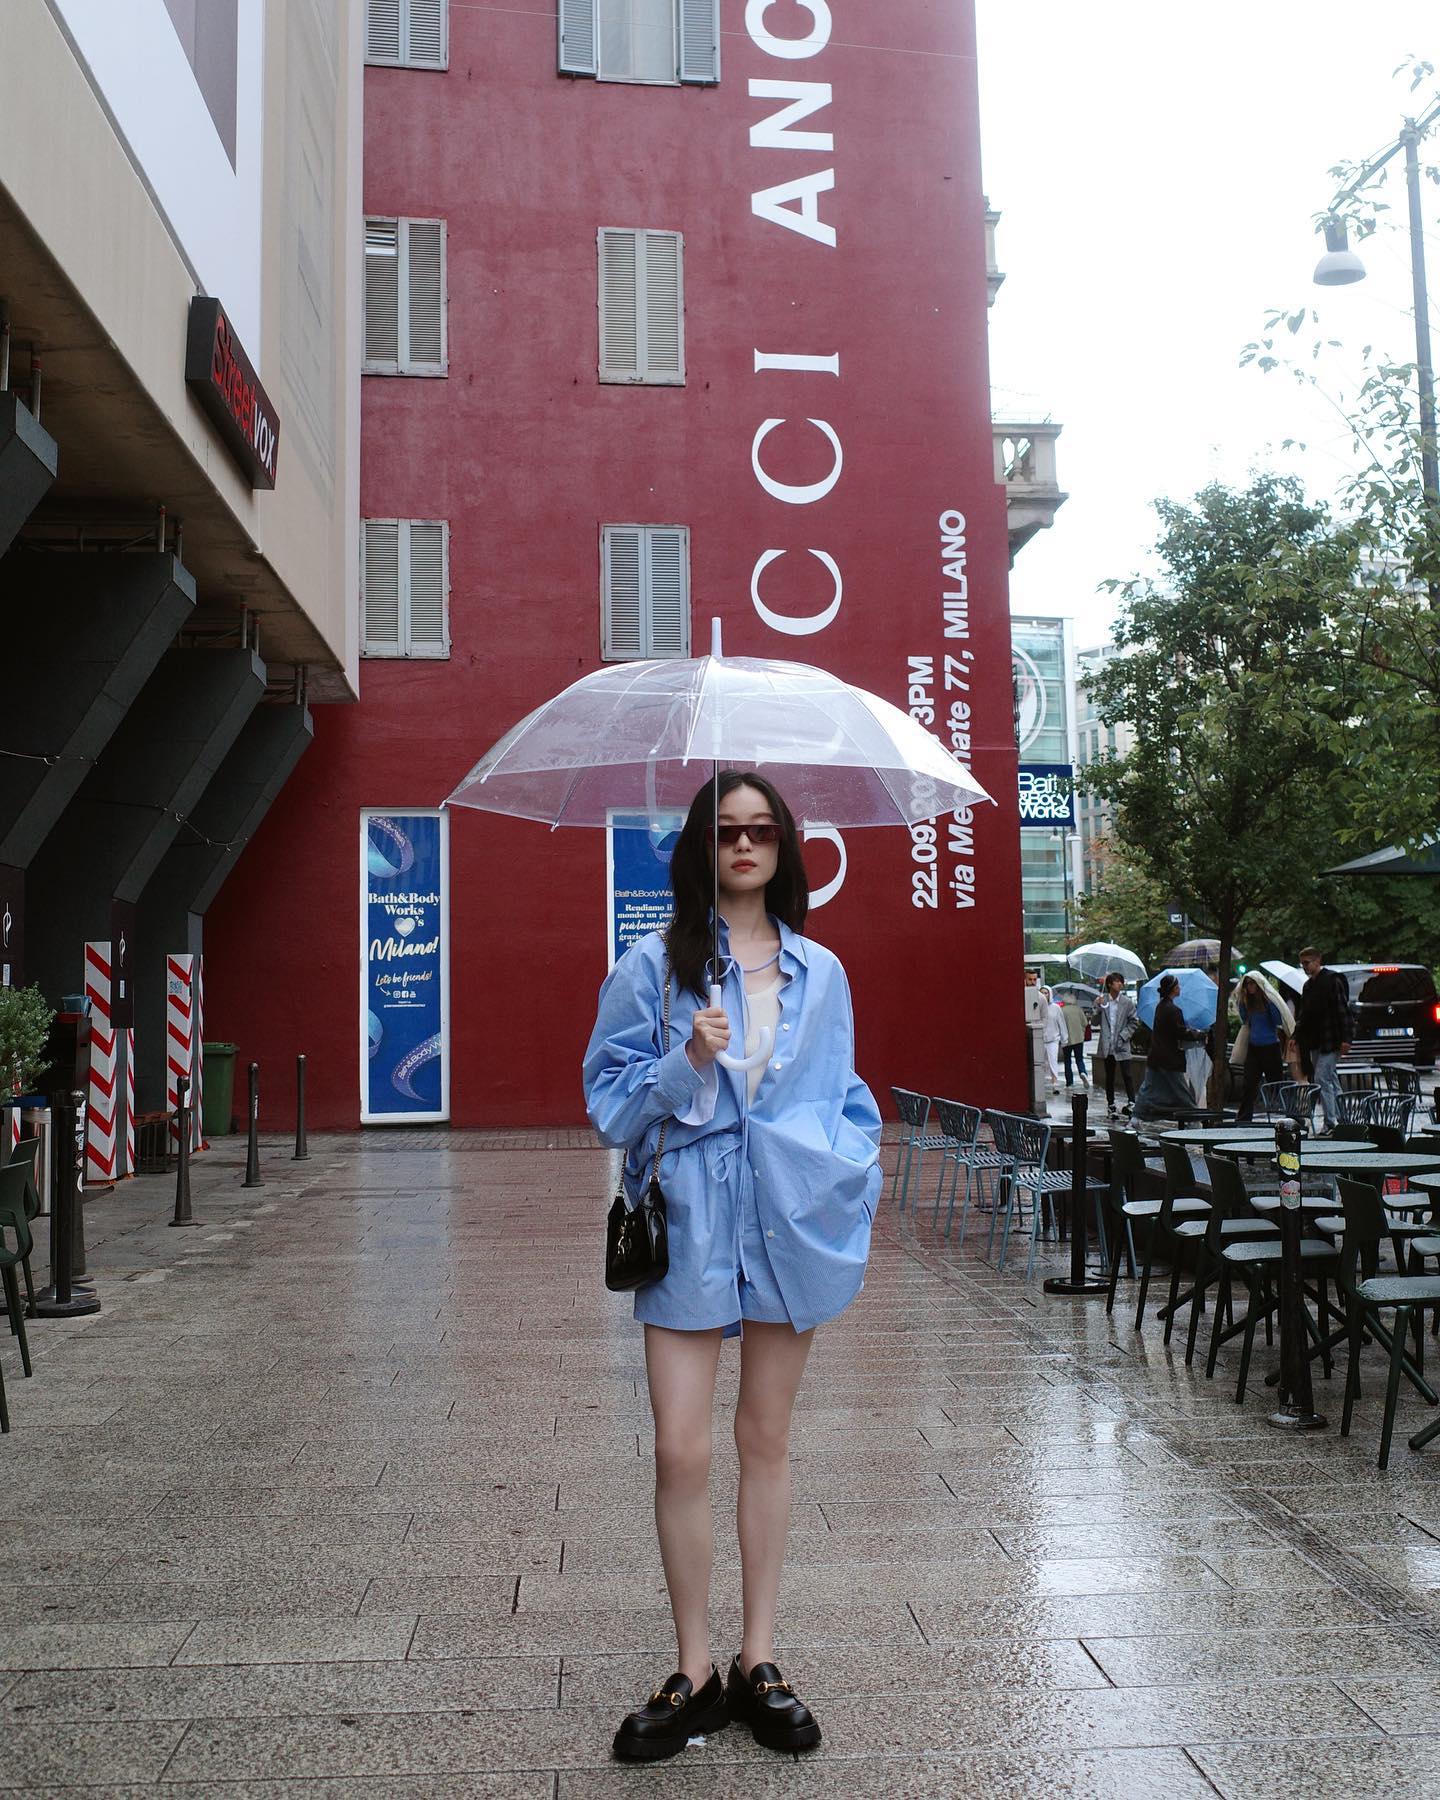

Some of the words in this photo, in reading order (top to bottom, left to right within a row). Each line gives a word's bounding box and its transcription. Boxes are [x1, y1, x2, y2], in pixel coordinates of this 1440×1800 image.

[938, 509, 970, 639] MILANO
[943, 650, 975, 692] 77,
[907, 655, 935, 725] 3PM
[945, 700, 975, 856] Mecnate
[1019, 804, 1070, 819] Works
[949, 864, 975, 909] via
[368, 892, 440, 906] Bath&Body
[625, 903, 665, 912] Rendiamo
[384, 904, 424, 915] Works
[617, 911, 644, 919] mondo
[369, 936, 439, 961] Milano!
[392, 972, 402, 983] be
